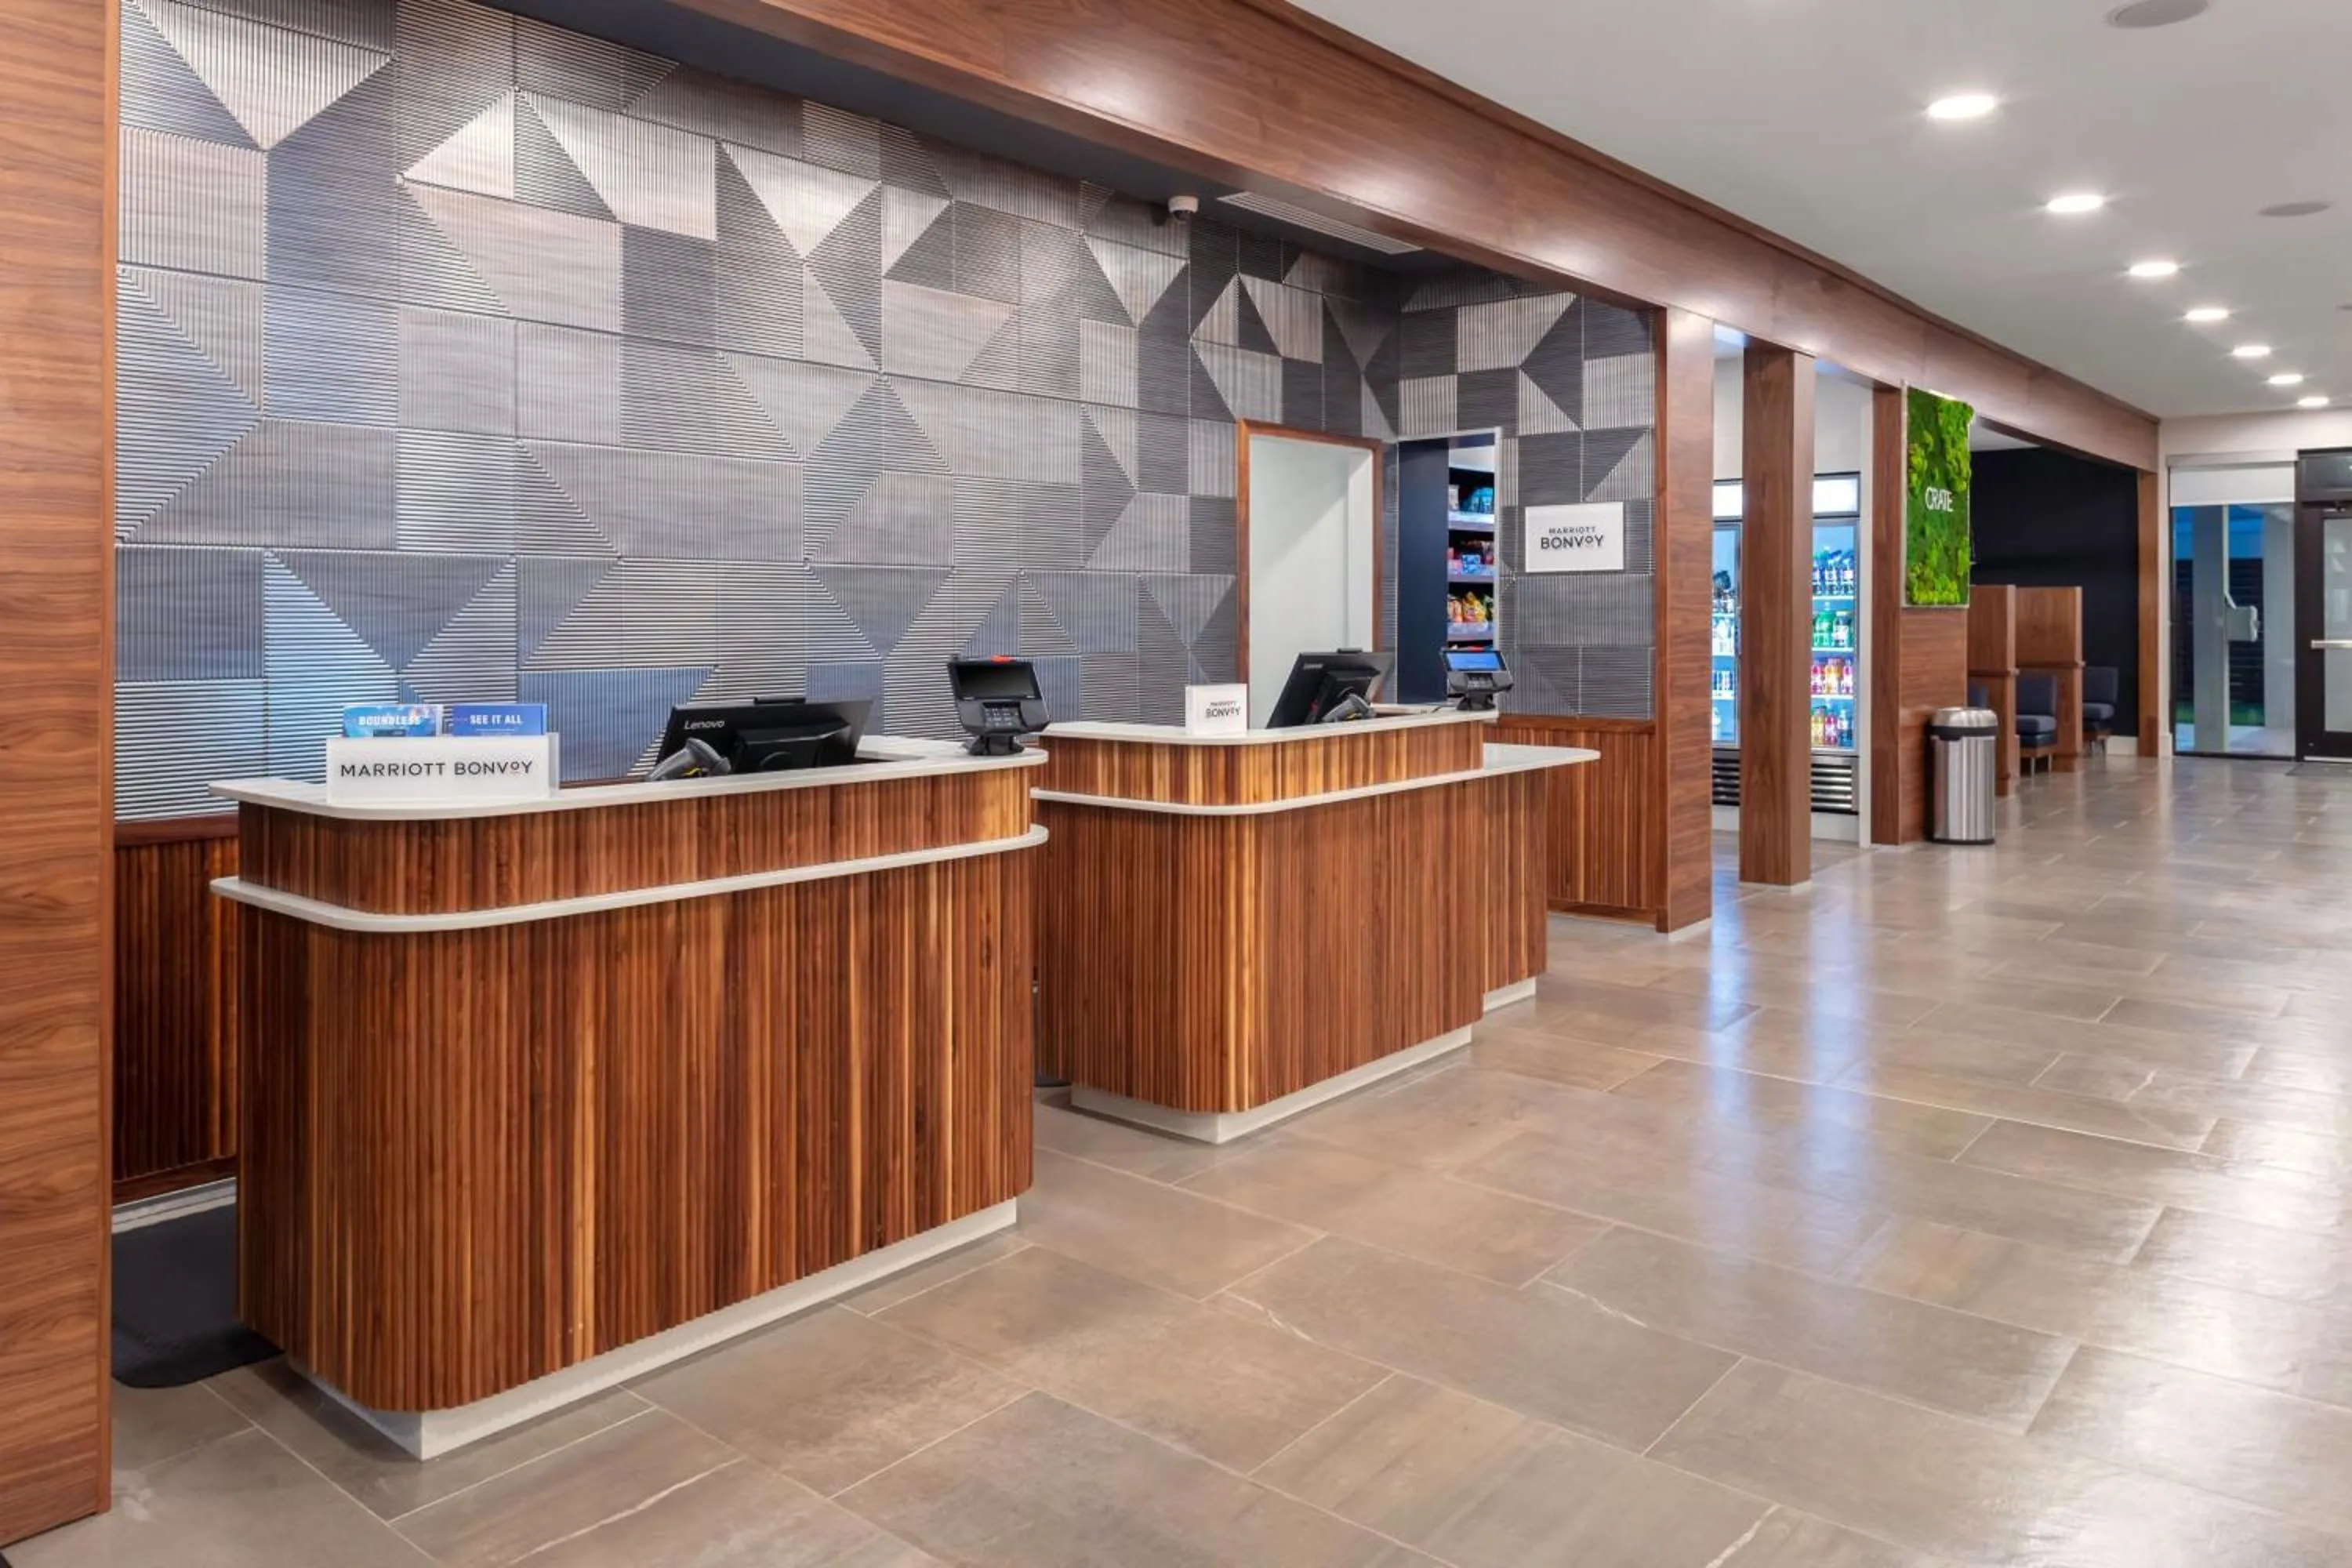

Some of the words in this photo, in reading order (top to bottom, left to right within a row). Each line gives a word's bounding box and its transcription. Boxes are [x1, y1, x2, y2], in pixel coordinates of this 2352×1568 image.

[1540, 535, 1605, 550] BONVOY
[358, 714, 421, 726] BOUNDLESS
[470, 714, 488, 725] SEE
[492, 714, 503, 725] IT
[505, 714, 522, 725] ALL
[684, 720, 725, 730] Lenovo
[340, 762, 446, 778] MARRIOTT
[454, 760, 533, 776] BONVOY
